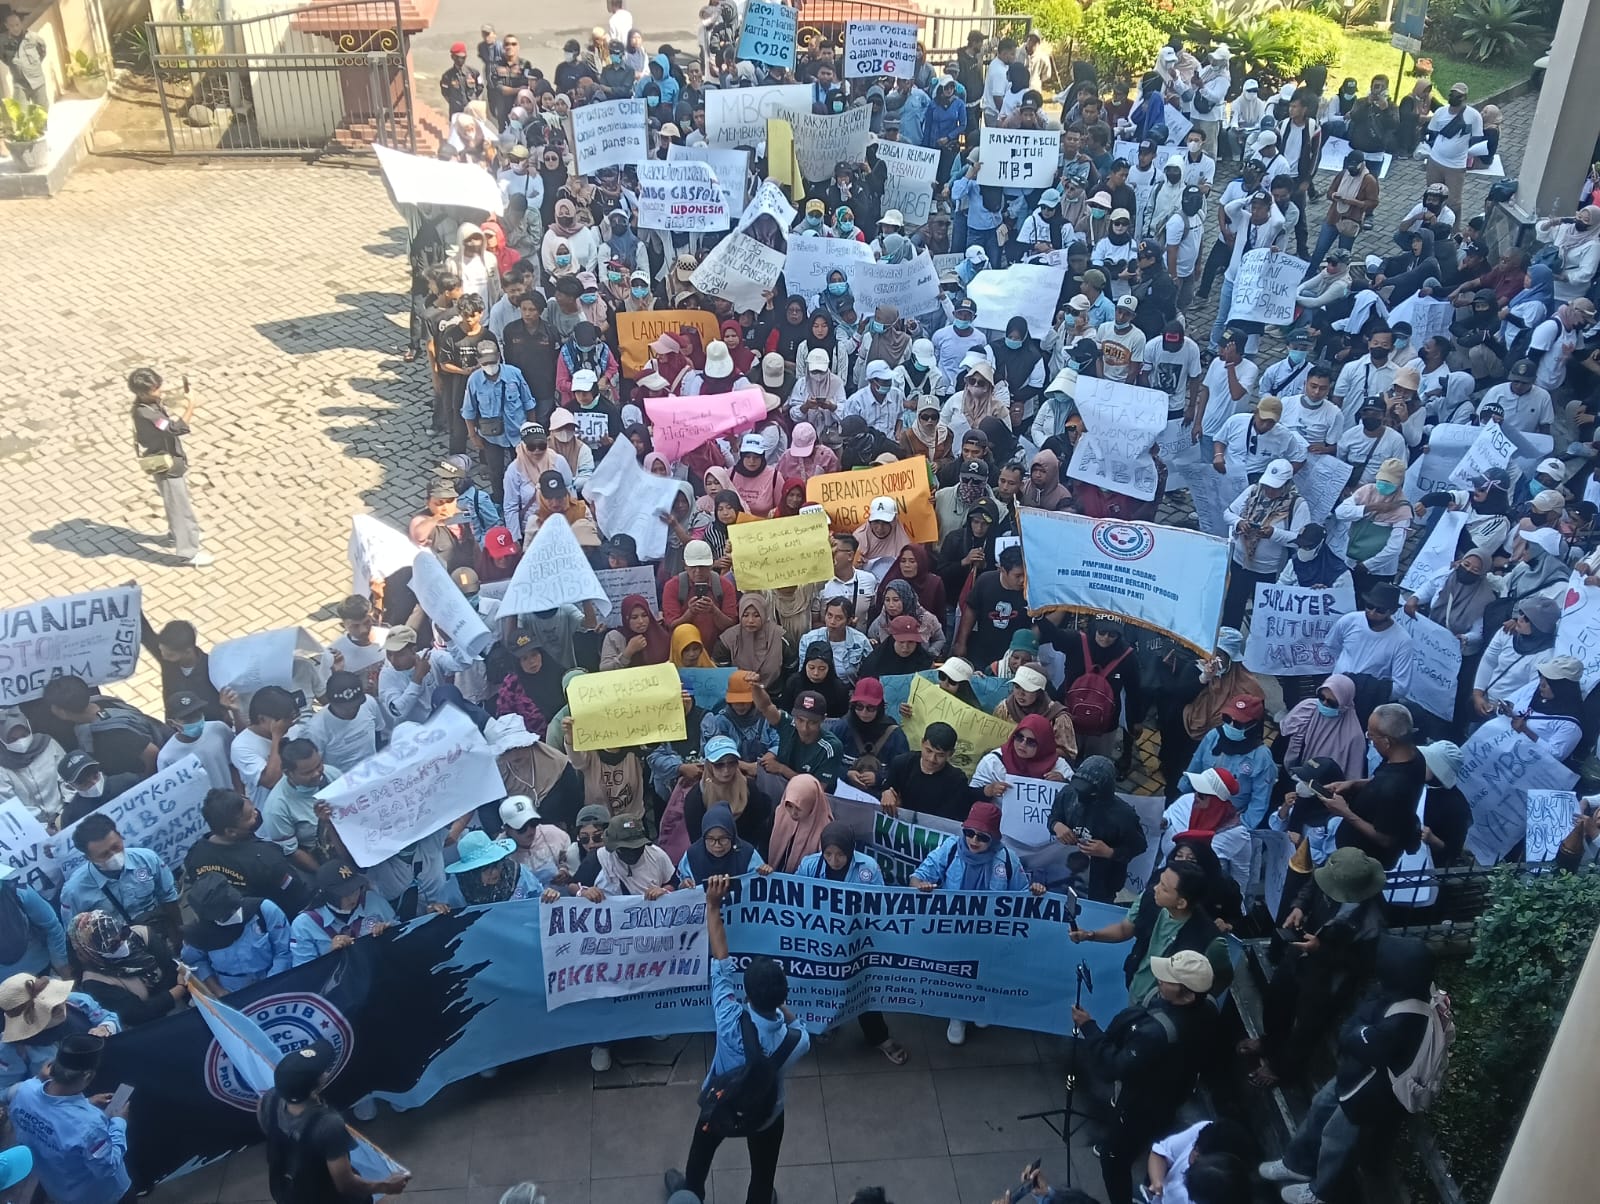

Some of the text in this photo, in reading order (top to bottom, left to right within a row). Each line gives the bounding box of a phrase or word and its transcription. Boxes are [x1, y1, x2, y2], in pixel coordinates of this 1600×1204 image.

[879, 143, 904, 159] EBAGAI
[671, 205, 723, 215] INDONESIA
[821, 470, 916, 503] BERANTAS KORUPSI
[1081, 559, 1113, 571] PIMPINAN
[1114, 562, 1131, 575] ANAK
[1088, 582, 1126, 597] KECAMATAN
[1091, 571, 1124, 585] INDONESIA
[1125, 577, 1152, 592] BERSATU
[1258, 588, 1345, 616] SUPLAYER
[1, 660, 94, 700] ROGAM
[1014, 781, 1058, 806] TERI
[873, 810, 952, 863] KAM
[750, 878, 804, 909] DAN
[812, 885, 991, 918] PERNYATAAN
[549, 905, 612, 936] AKU
[620, 902, 707, 930] JANDA
[741, 906, 1029, 938] MASYARAKAT JEMBER
[780, 935, 875, 957] BERSAMA
[790, 954, 893, 978] KABUPATEN
[897, 956, 973, 977] JEMBER
[920, 976, 972, 990] Prabowo
[256, 1003, 316, 1023] OGIB
[655, 1001, 677, 1010] dan
